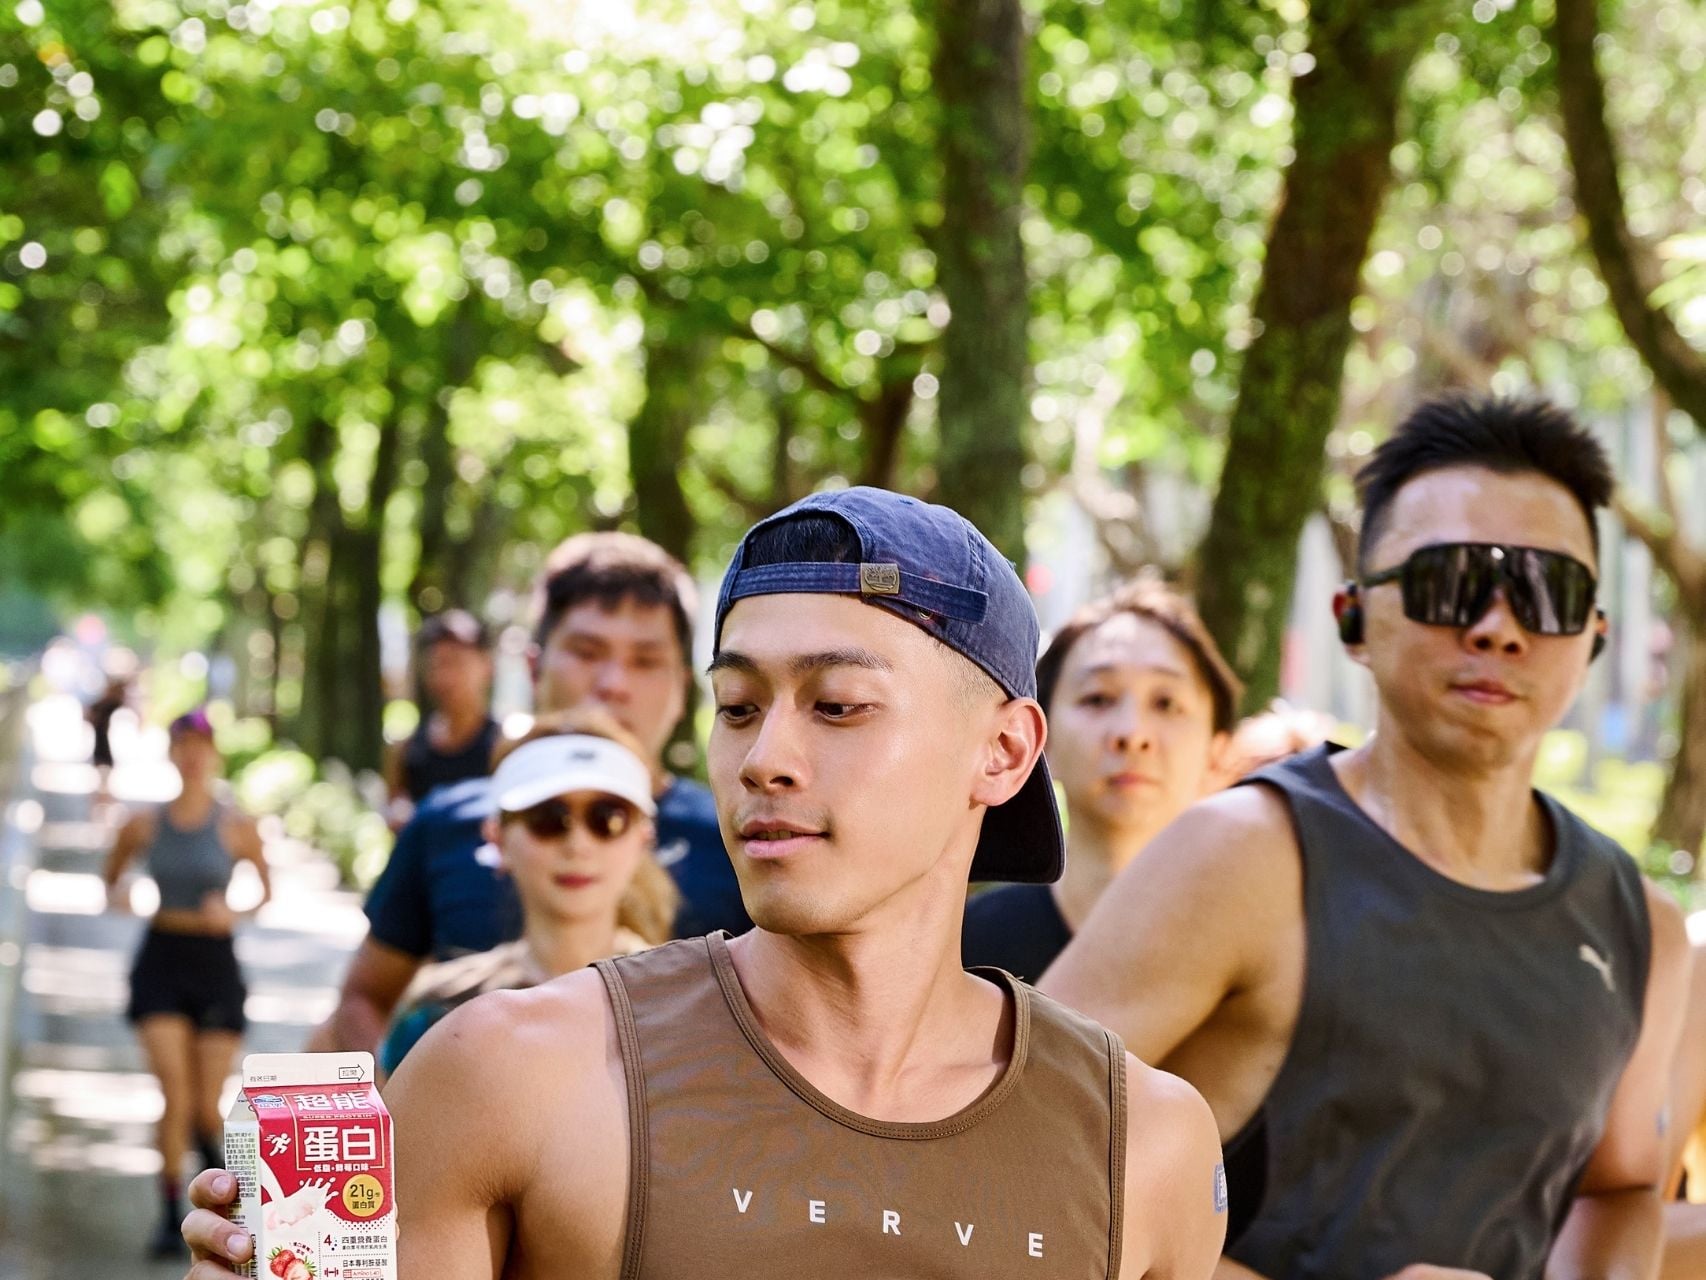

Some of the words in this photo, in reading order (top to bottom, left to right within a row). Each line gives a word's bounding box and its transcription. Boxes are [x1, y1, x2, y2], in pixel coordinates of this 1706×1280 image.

[293, 1091, 370, 1111] 超能
[304, 1126, 376, 1162] 蛋白
[350, 1184, 374, 1200] 21g
[352, 1201, 375, 1209] 蛋白質
[732, 1188, 1044, 1258] VERVE
